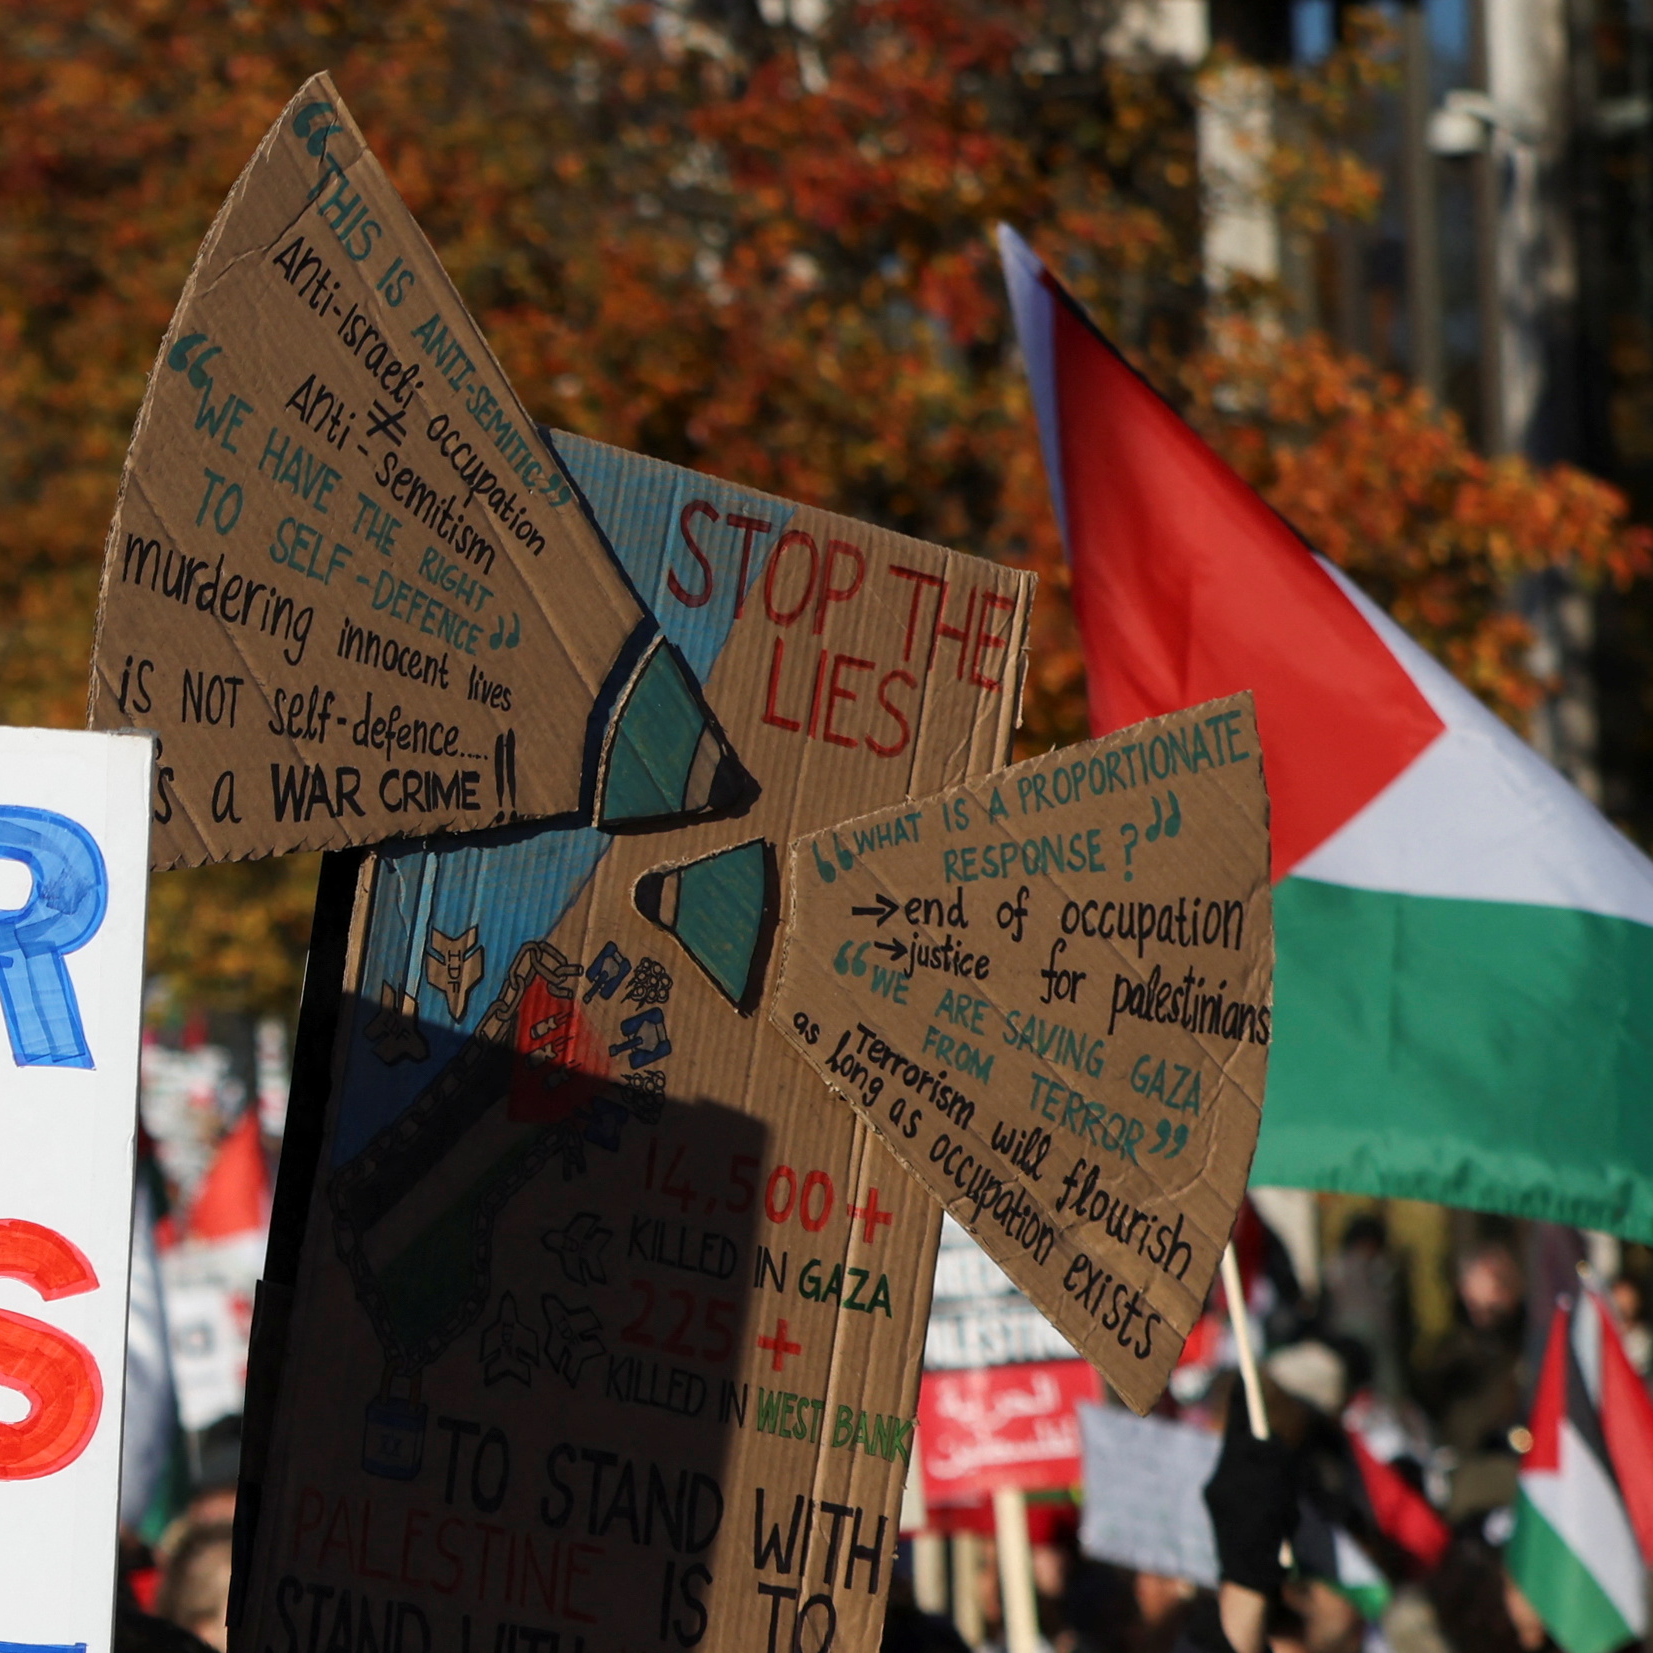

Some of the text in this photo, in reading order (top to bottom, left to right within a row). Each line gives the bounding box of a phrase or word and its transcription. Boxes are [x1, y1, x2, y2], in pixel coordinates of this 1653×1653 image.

[377, 256, 415, 307] IS
[195, 467, 243, 536] TO
[260, 427, 342, 513] HAVE
[357, 492, 403, 557] THE
[419, 547, 495, 613] RIGHT
[427, 414, 546, 557] occupation
[123, 533, 511, 712] murdering innocent lives
[667, 498, 1015, 694] STOP THE
[182, 672, 244, 729] NOT
[762, 637, 918, 758] LIES
[212, 770, 242, 824] a
[270, 763, 364, 823] WAR
[942, 798, 970, 833] IS
[988, 786, 1010, 825] A
[1017, 709, 1250, 814] PROPORTIONATE
[904, 885, 1244, 958] end of occupation
[903, 932, 1271, 1046] justice for palestinians
[921, 1026, 996, 1085] FROM
[934, 988, 990, 1036] ARE
[1002, 1009, 1105, 1078] SAVING
[1130, 1053, 1202, 1117] GAZA
[793, 1011, 821, 1046] as
[888, 1098, 923, 1139] as
[929, 1132, 1057, 1267] occupation
[1063, 1251, 1163, 1360] exists
[854, 1022, 976, 1131] Terrorism
[991, 1120, 1053, 1181] will
[1055, 1159, 1193, 1280] flourish
[620, 1278, 737, 1363] 225
[627, 1214, 738, 1280] KILLED
[754, 1245, 788, 1293] IN
[798, 1258, 892, 1319] GAZA
[605, 1354, 913, 1468] KILLED IN WEST BANK
[436, 1414, 888, 1595] TO STAND WITH
[293, 1485, 606, 1624] PALESTINE
[659, 1559, 713, 1649] IS
